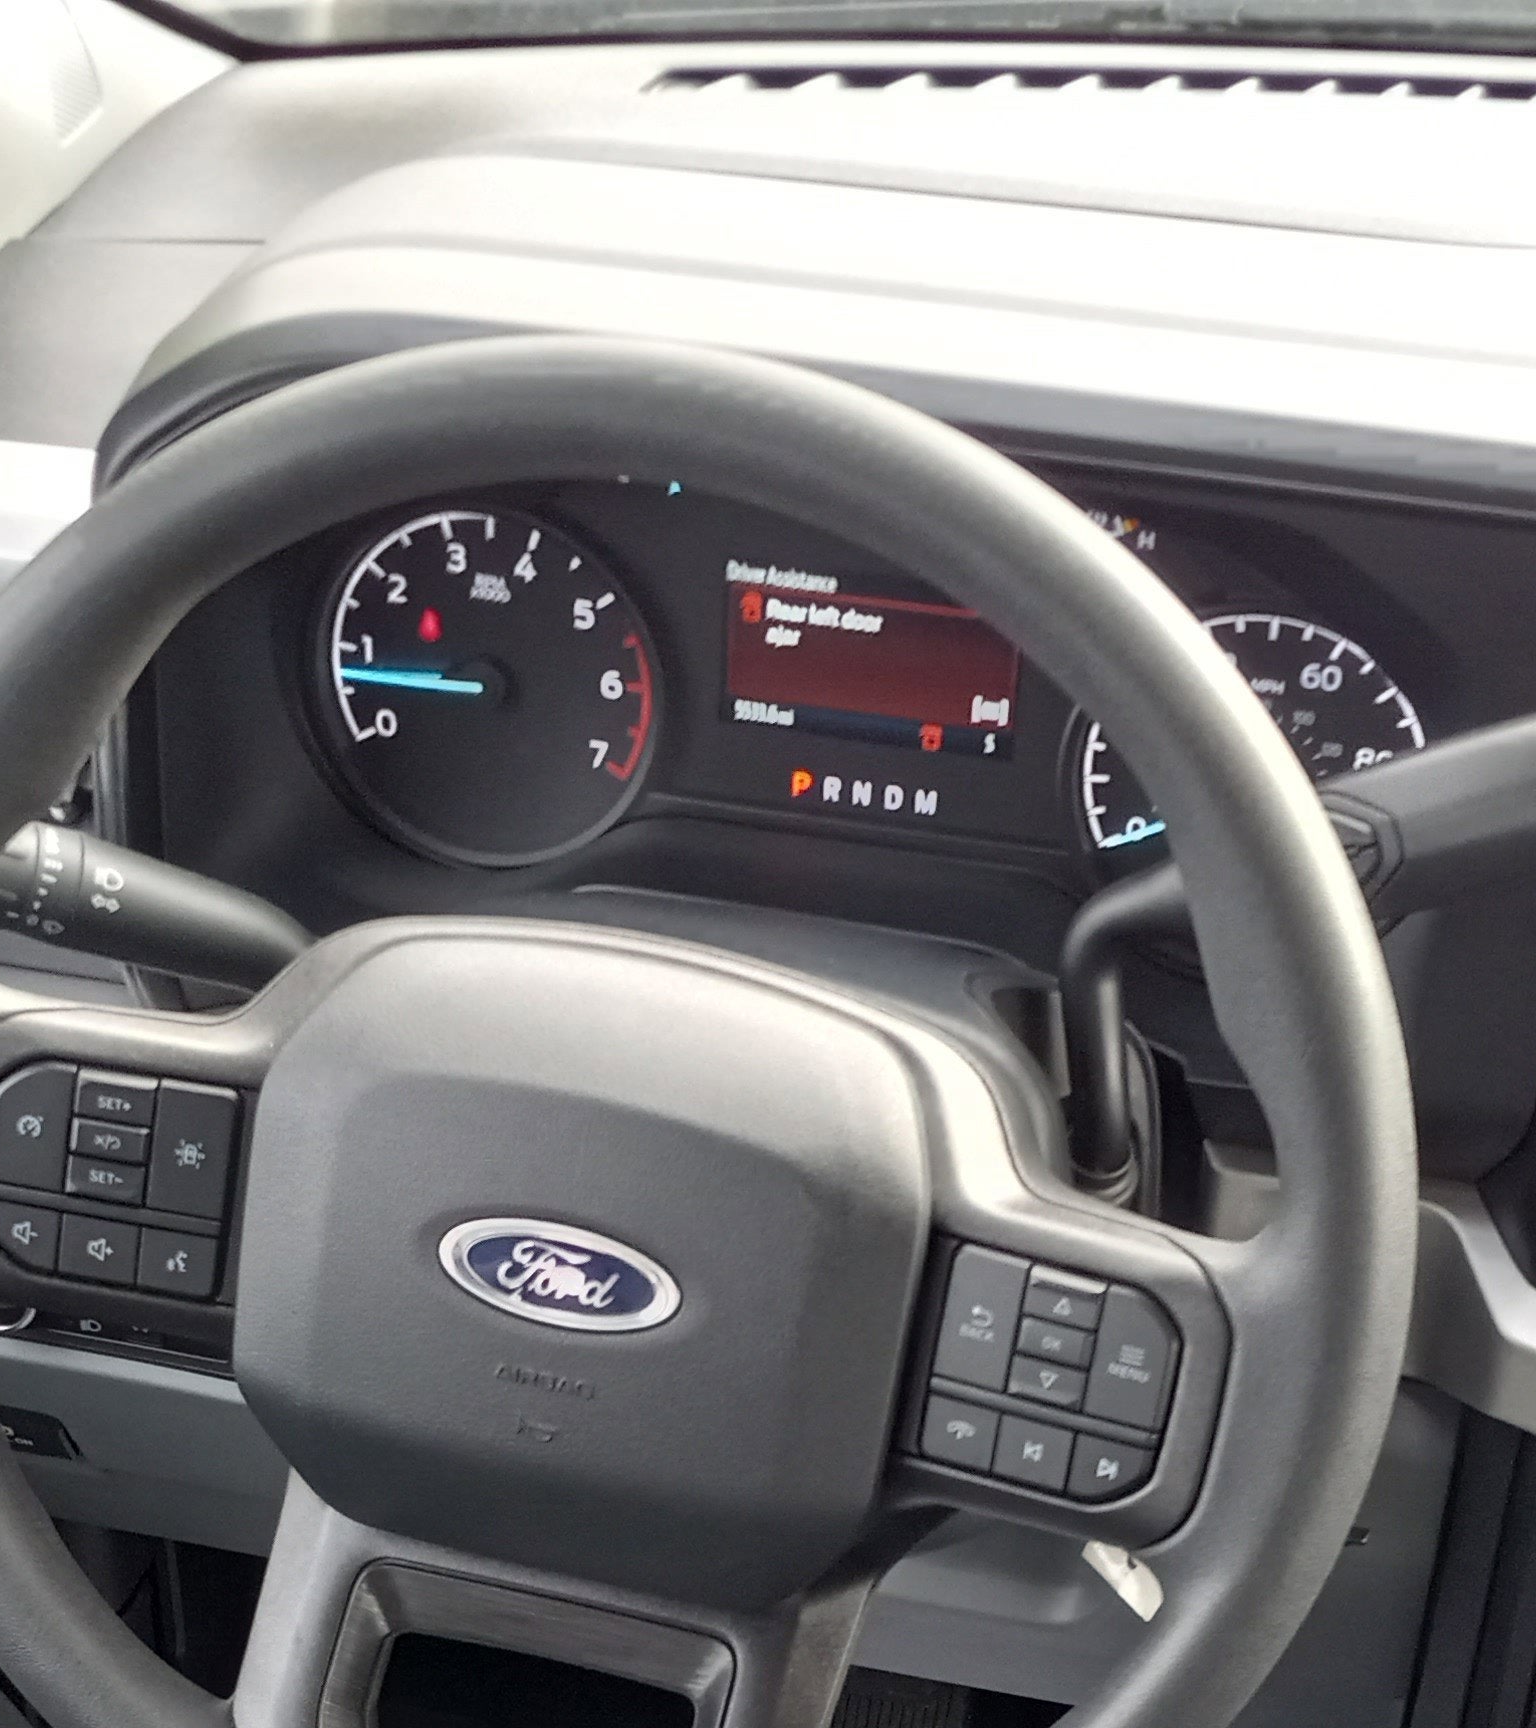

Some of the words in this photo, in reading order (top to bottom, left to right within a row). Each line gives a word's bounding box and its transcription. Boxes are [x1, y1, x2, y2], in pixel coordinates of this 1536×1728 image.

[446, 542, 467, 574] 3
[513, 552, 538, 584] 4
[387, 576, 408, 602] 2
[573, 599, 595, 630] 5
[361, 635, 373, 663] 1
[601, 669, 623, 699] 6
[1300, 662, 1343, 692] 60
[375, 708, 397, 738] 0
[589, 739, 609, 769] 7
[791, 769, 814, 798] P
[823, 775, 842, 802] R
[852, 780, 872, 807] N
[884, 784, 904, 811] D
[915, 788, 938, 816] M
[497, 1240, 620, 1310] Ford
